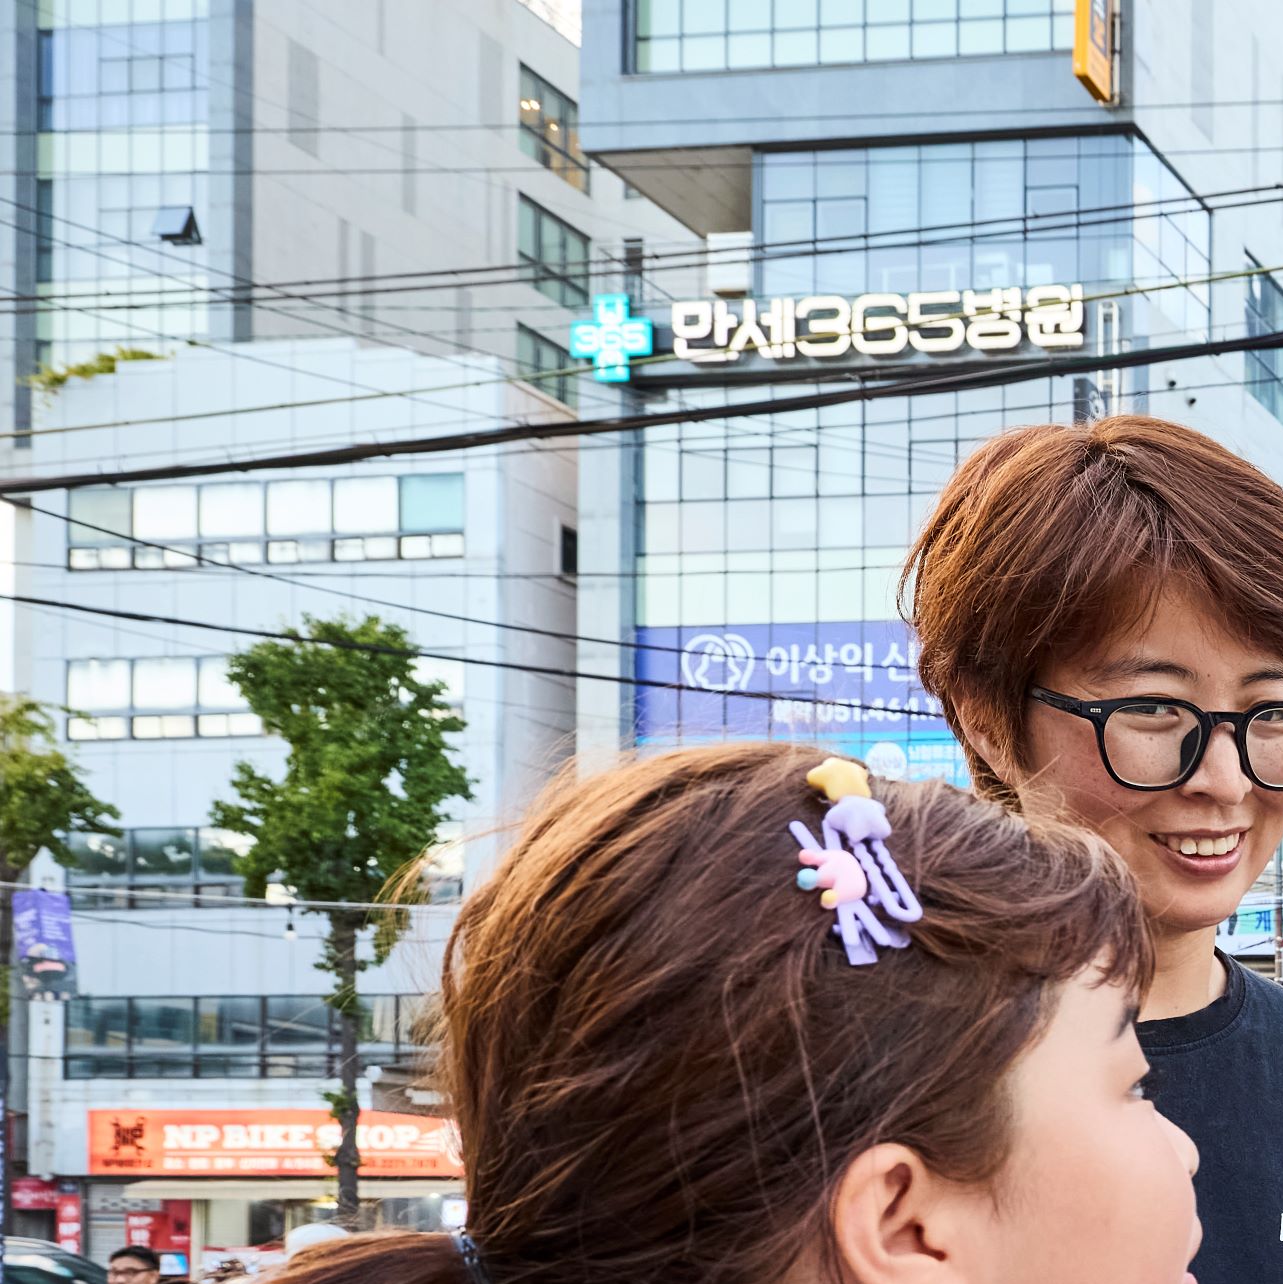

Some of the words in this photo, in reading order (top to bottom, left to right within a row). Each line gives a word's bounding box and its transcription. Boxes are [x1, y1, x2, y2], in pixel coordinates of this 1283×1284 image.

[575, 322, 646, 351] 365
[670, 284, 1085, 362] 만세365병원
[163, 1124, 220, 1149] NP
[222, 1124, 313, 1149] BIKE
